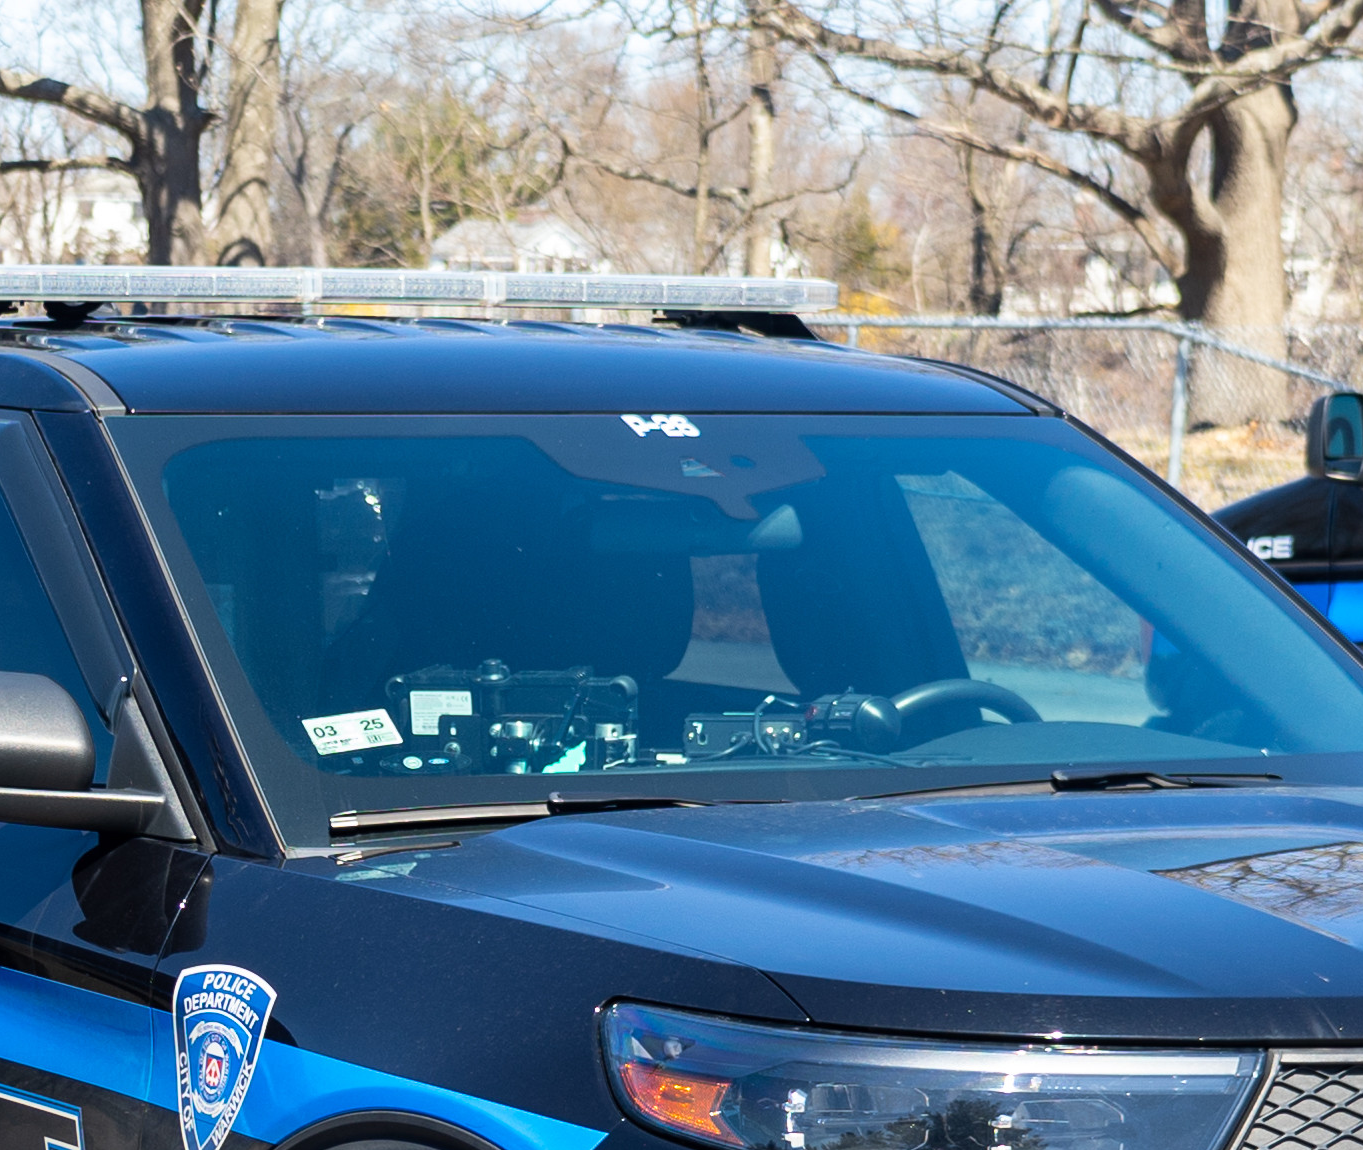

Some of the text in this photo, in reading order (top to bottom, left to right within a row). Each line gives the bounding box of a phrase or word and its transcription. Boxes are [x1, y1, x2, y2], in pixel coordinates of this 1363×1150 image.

[313, 717, 384, 738] 03 25
[202, 973, 257, 1001] POLICE
[184, 991, 259, 1030] DEPARTMENT
[179, 1051, 194, 1133] CITY OF
[211, 1059, 254, 1146] WARWICK
